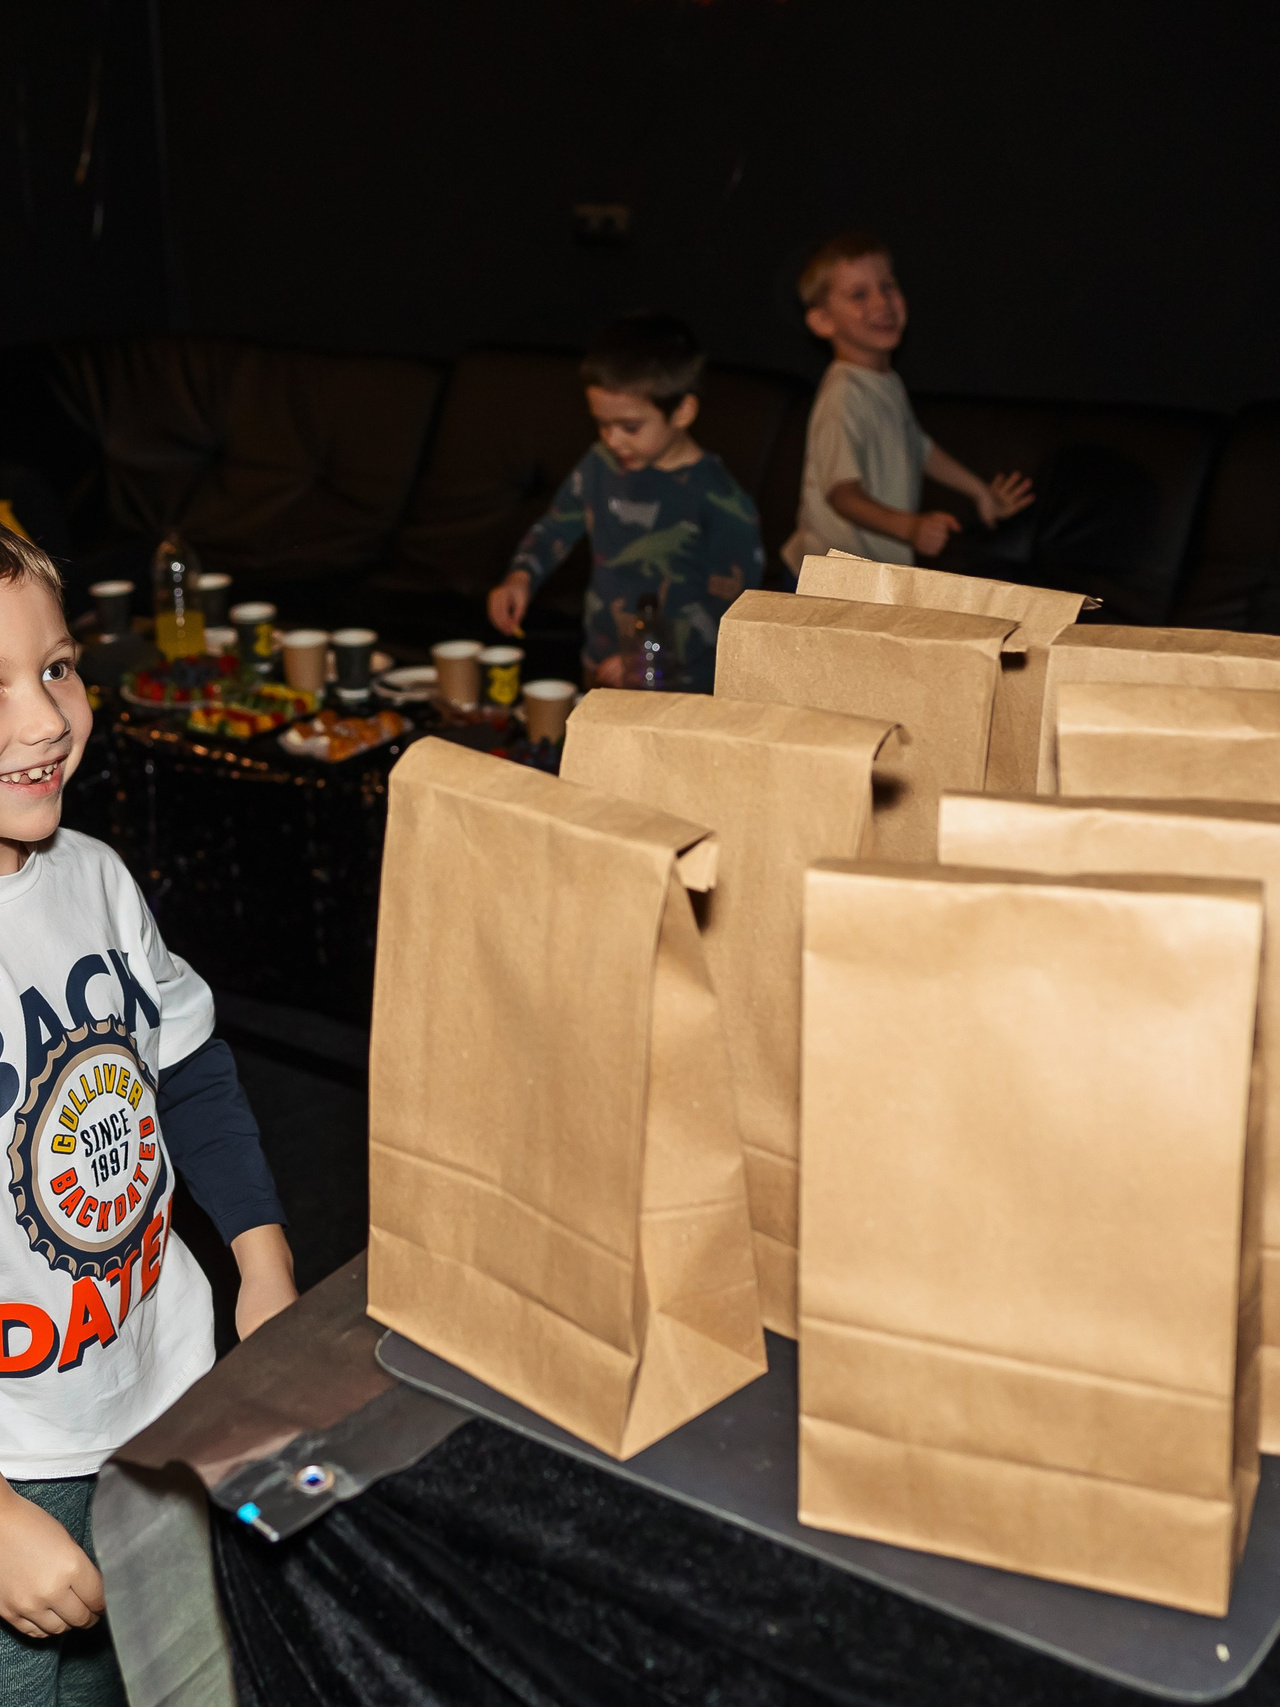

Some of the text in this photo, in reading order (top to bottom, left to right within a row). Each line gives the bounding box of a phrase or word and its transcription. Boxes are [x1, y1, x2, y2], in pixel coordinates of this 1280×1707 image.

[51, 1063, 144, 1155] GULLIVER
[80, 1108, 131, 1158] SINCE
[50, 1115, 156, 1232] BACKDATED
[90, 1141, 130, 1188] 1997
